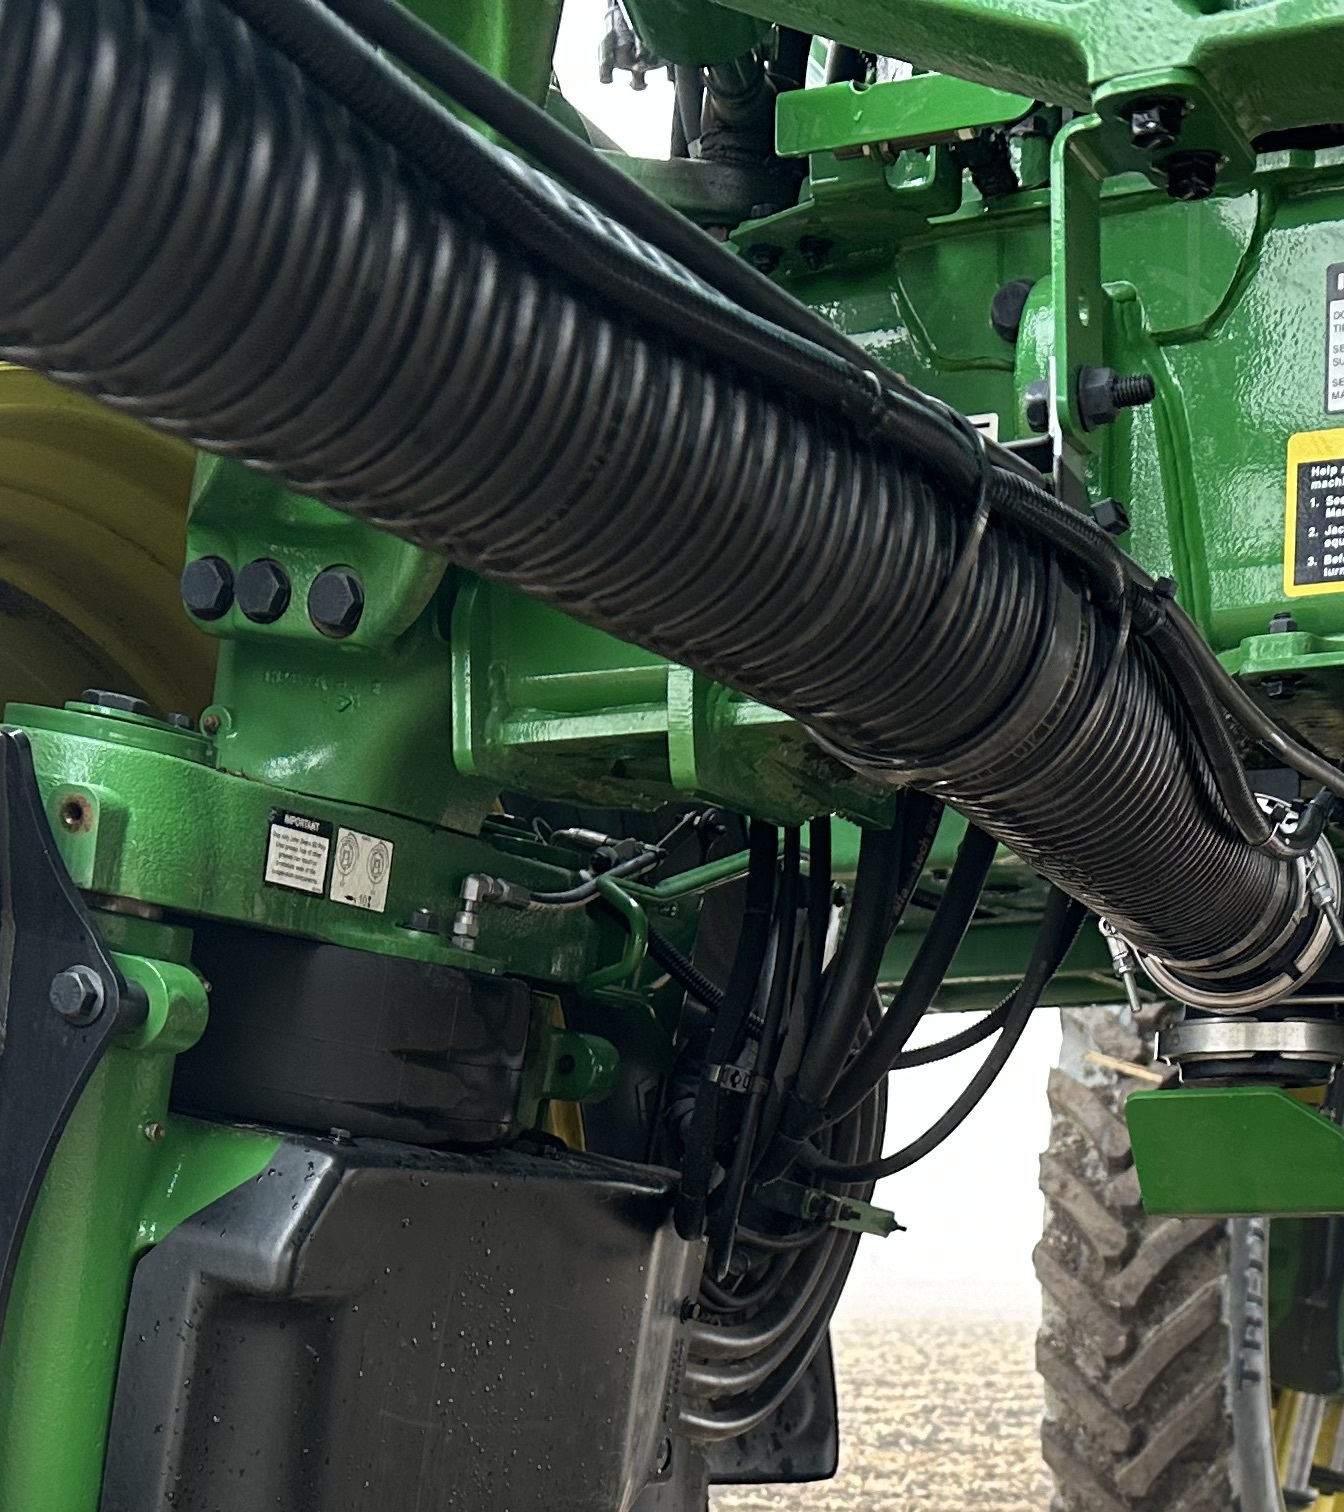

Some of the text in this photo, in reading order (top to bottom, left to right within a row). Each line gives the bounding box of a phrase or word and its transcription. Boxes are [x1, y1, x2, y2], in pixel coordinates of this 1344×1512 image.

[1311, 466, 1338, 478] Help
[1310, 497, 1320, 508] 1.
[1308, 527, 1319, 538] 2.
[1307, 556, 1318, 567] 3.
